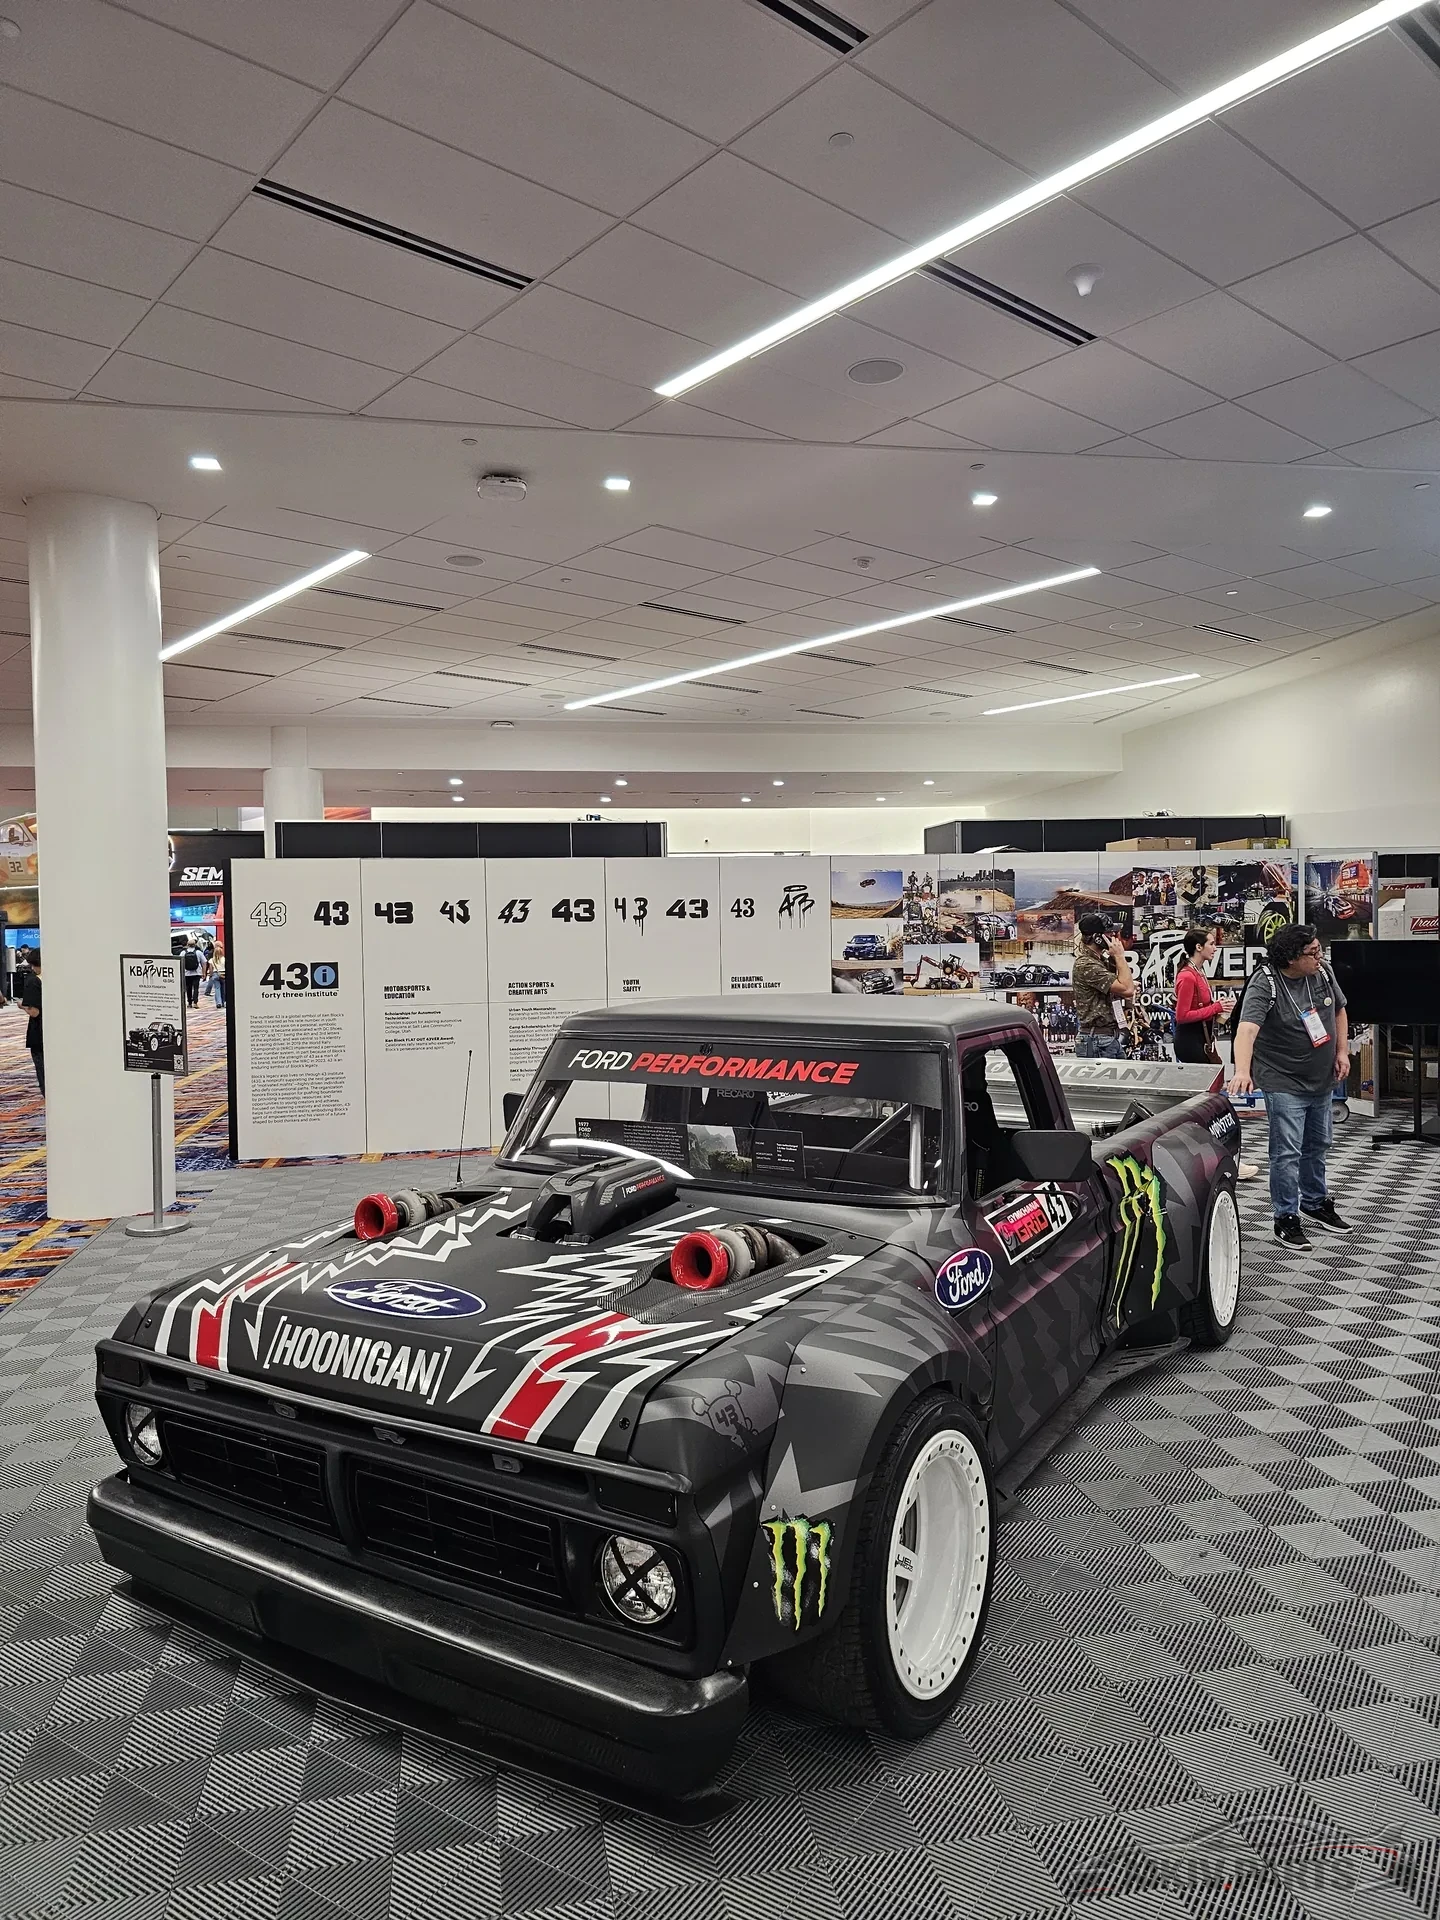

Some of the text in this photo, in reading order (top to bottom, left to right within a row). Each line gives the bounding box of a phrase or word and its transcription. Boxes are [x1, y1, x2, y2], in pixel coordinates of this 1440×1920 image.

[9, 861, 23, 872] 32
[250, 900, 350, 927] 43 43
[374, 901, 414, 924] 43
[497, 898, 595, 924] 43 43
[614, 897, 710, 931] 43 43
[730, 898, 755, 918] 43
[261, 991, 281, 1000] forty
[384, 984, 425, 992] MOTORSPORTS
[508, 981, 528, 989] ACTION
[508, 988, 533, 996] CREATIVE
[622, 985, 641, 993] SAFETY
[730, 982, 741, 990] KEN
[762, 981, 781, 989] LEGACY
[384, 992, 415, 1000] EDUCATION
[567, 1049, 860, 1085] FORD PERFORMANCE
[716, 1088, 755, 1098] RECARO
[1006, 1200, 1040, 1224] GYMKHANA
[946, 1255, 986, 1303] Ford
[345, 1281, 460, 1313] Ford
[263, 1315, 452, 1406] [HOONIGAN]
[715, 1404, 738, 1426] 43
